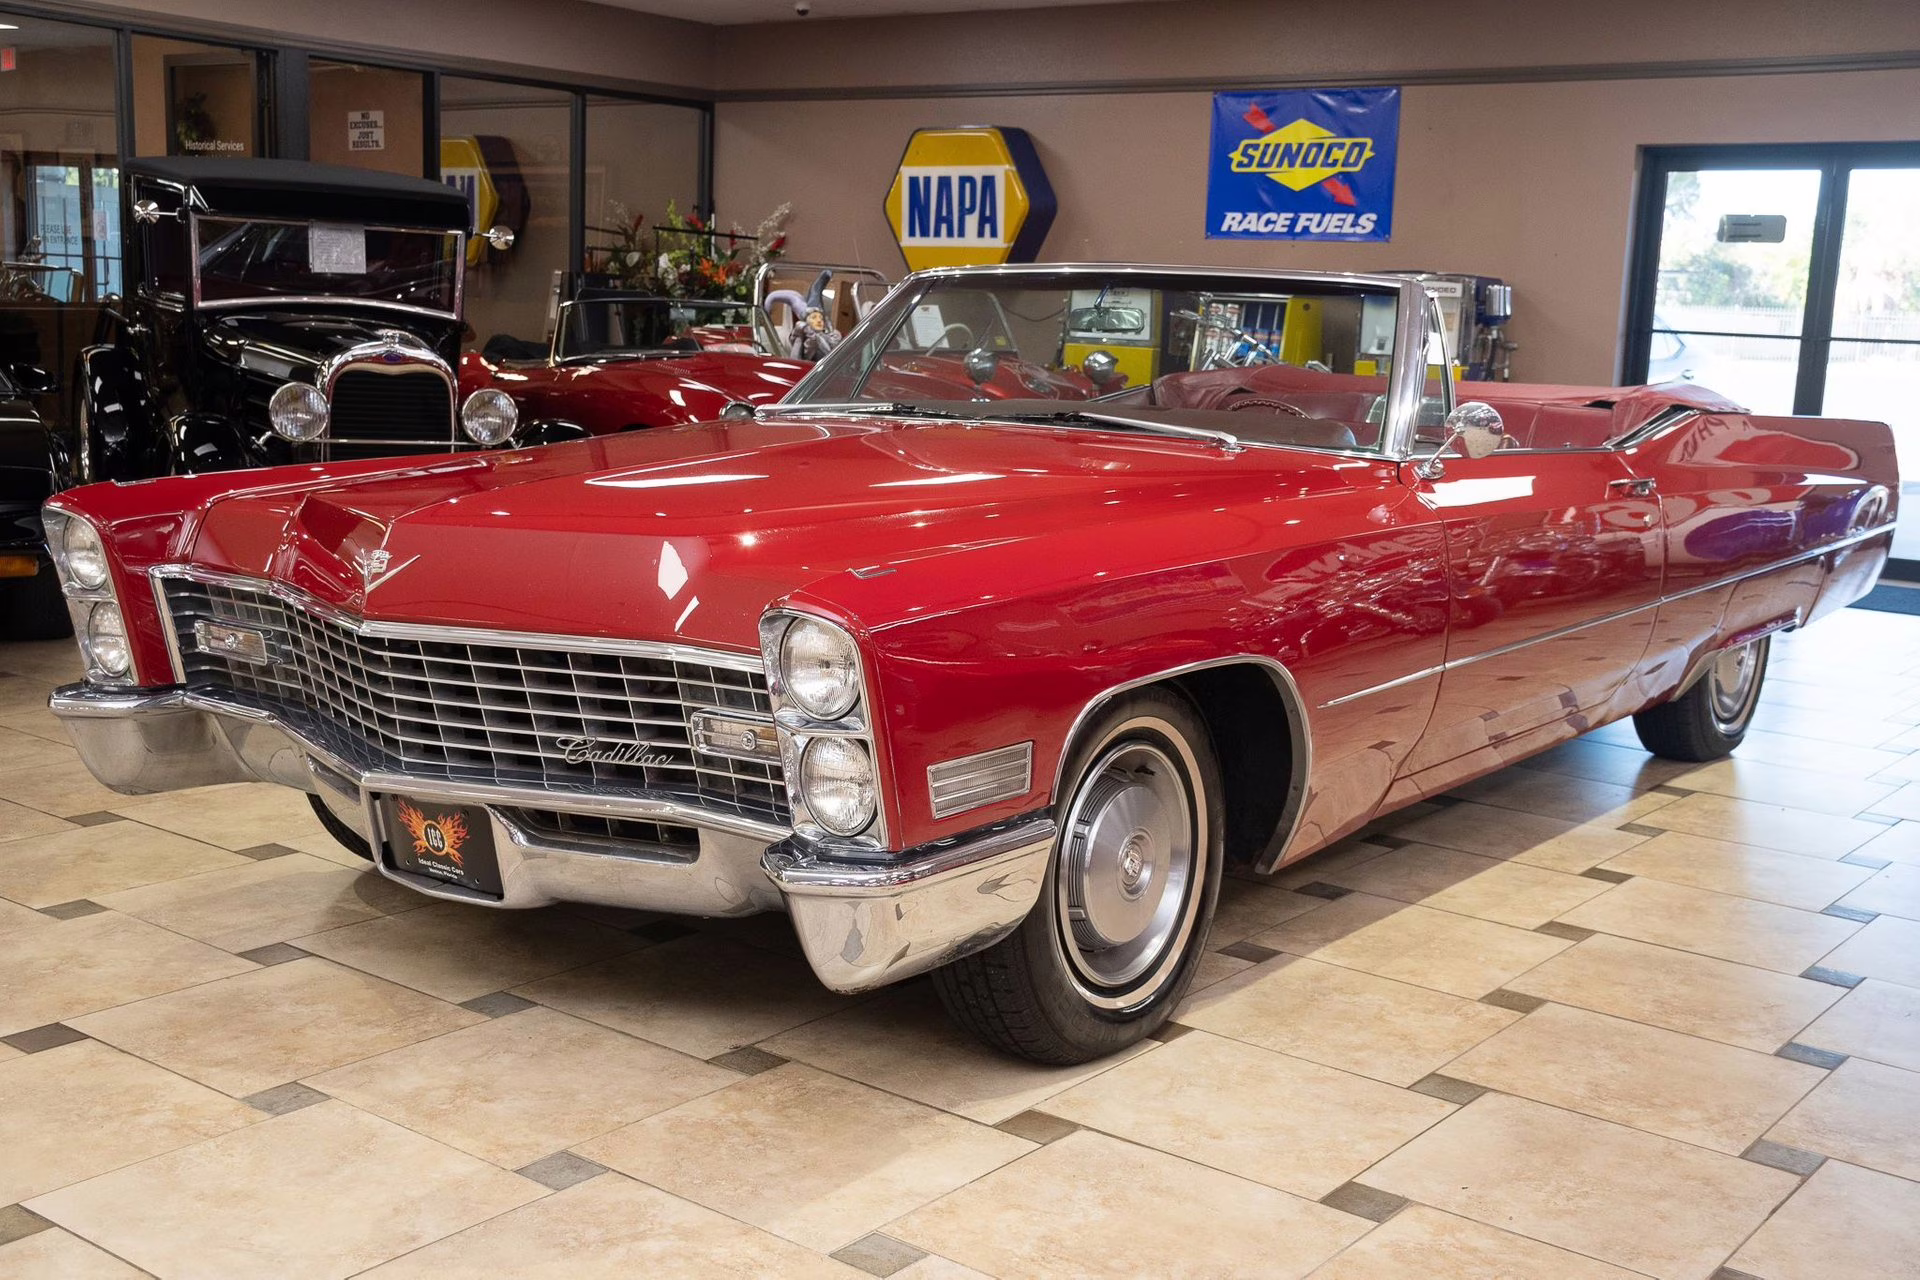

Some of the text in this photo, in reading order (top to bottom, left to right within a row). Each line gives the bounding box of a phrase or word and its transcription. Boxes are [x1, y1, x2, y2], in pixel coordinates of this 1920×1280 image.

[185, 139, 245, 151] Historical Services
[1235, 141, 1369, 169] SUNOCO
[908, 175, 998, 238] NAPA
[1220, 211, 1378, 234] RACE FUELS
[556, 736, 674, 765] Cadillac
[427, 827, 443, 850] ICC
[451, 866, 465, 876] Cars
